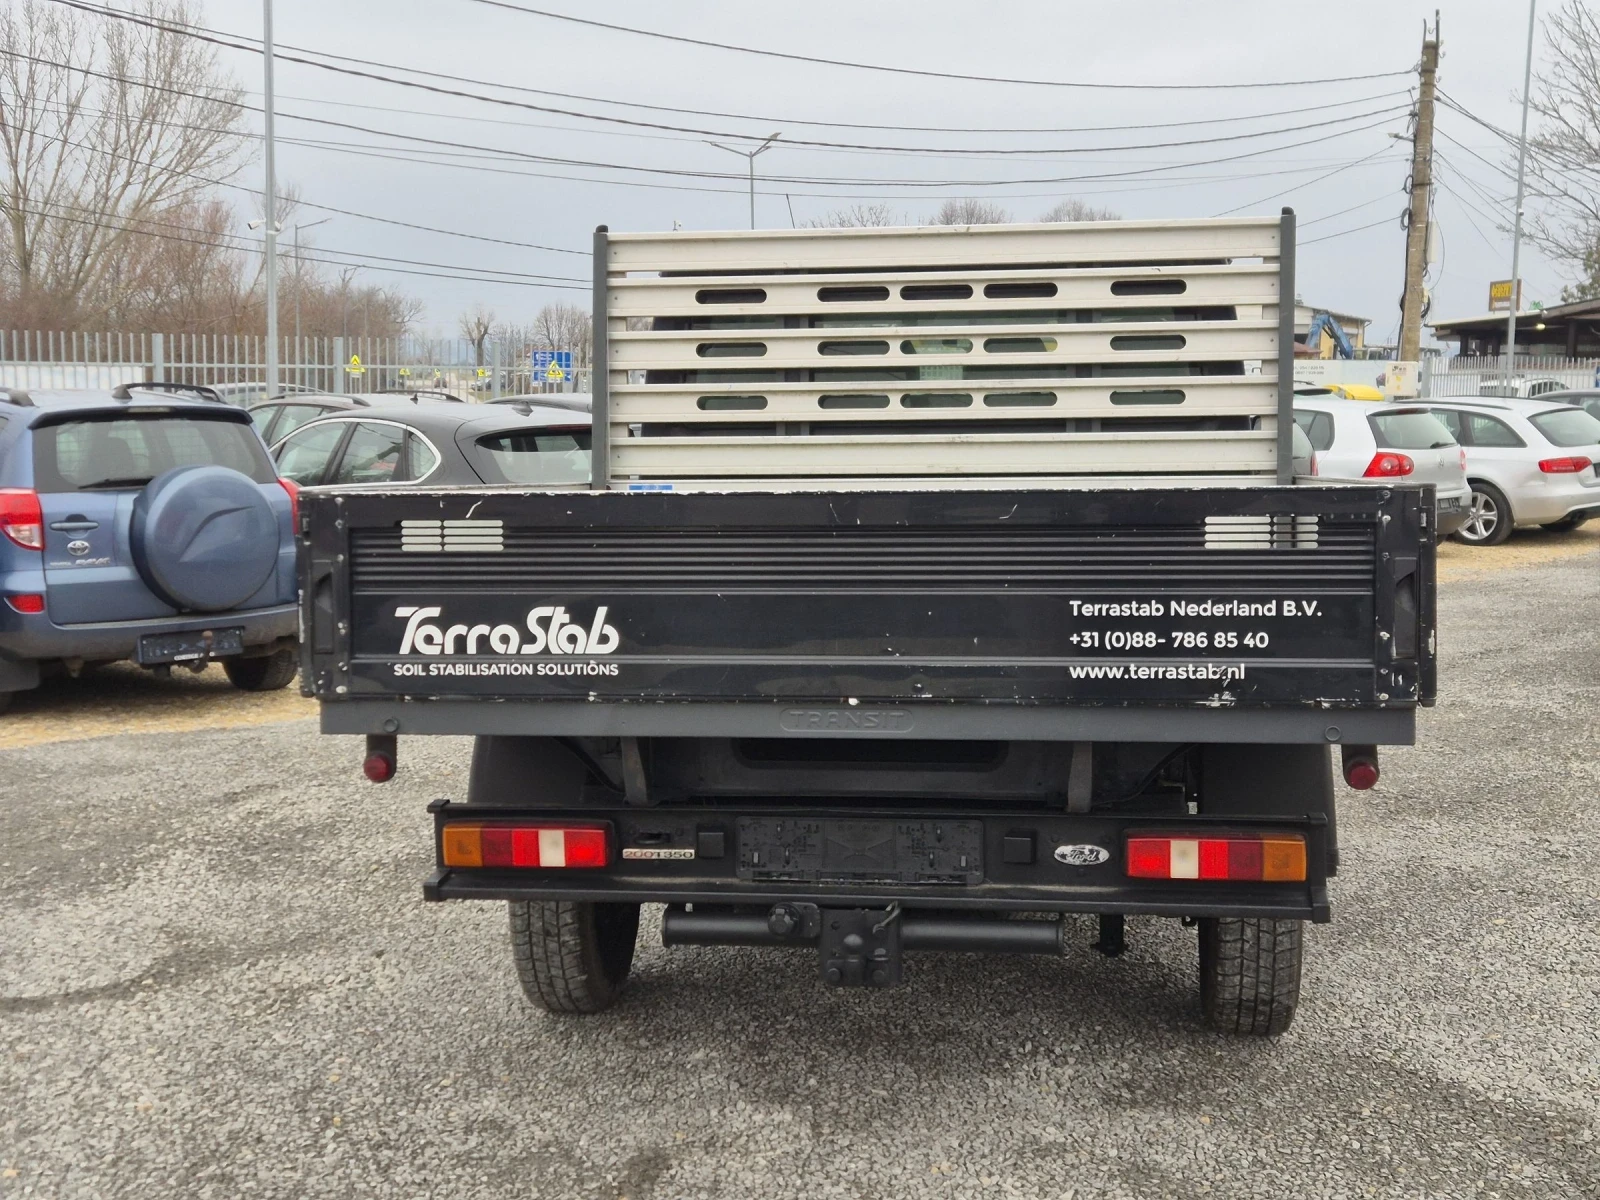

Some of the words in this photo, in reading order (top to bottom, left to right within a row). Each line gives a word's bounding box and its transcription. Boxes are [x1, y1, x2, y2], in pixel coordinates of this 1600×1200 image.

[1069, 600, 1164, 617] Terrastab
[1170, 600, 1276, 617] Nederland
[1283, 601, 1322, 617] B.V.
[1070, 632, 1099, 648] +31
[1171, 632, 1208, 648] 786
[1213, 632, 1238, 648] 85
[1243, 632, 1269, 648] 40
[394, 664, 426, 676] SOIL
[429, 664, 533, 676] STABILISATION
[537, 663, 618, 676] SOLUTIONS
[1069, 664, 1245, 680] www.terrastab.nl
[790, 711, 905, 729] TRANSIT
